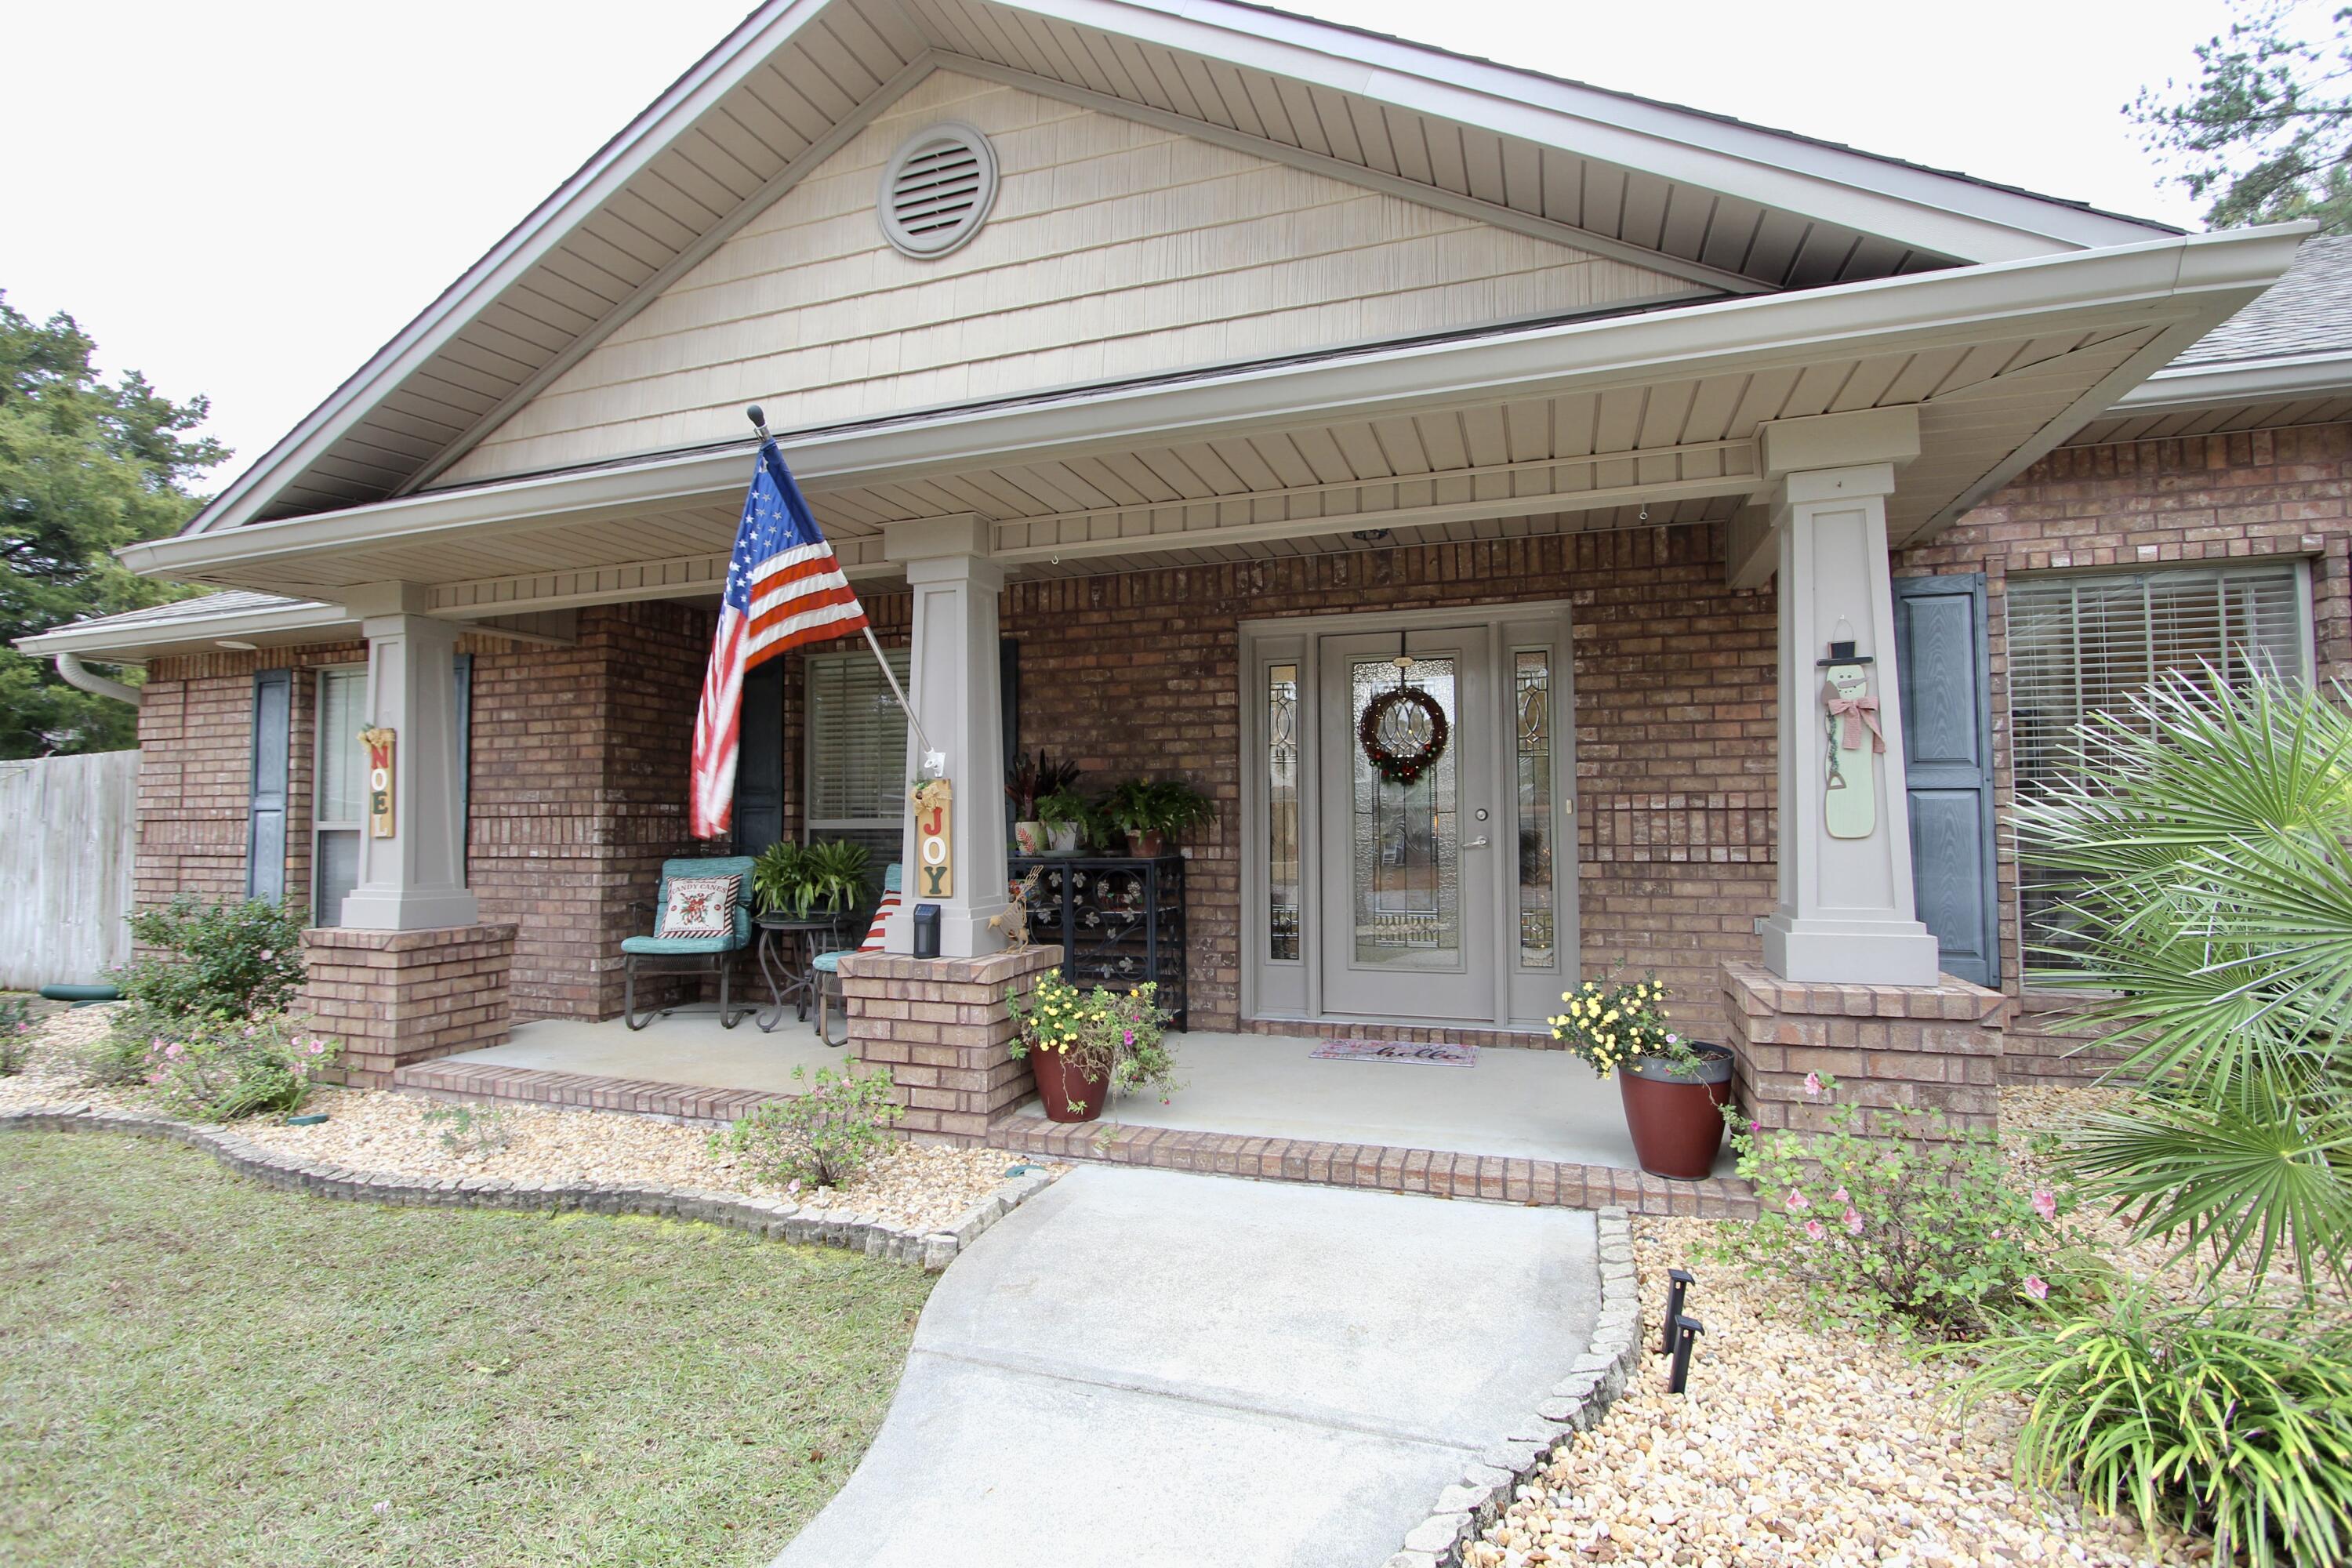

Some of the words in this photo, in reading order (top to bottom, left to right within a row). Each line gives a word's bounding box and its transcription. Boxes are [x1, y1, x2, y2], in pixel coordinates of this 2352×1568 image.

[371, 745, 389, 837] NOEL
[923, 806, 948, 895] JOY
[672, 884, 699, 894] CANDY
[700, 884, 728, 893] CANES
[1374, 1047, 1464, 1059] hello
